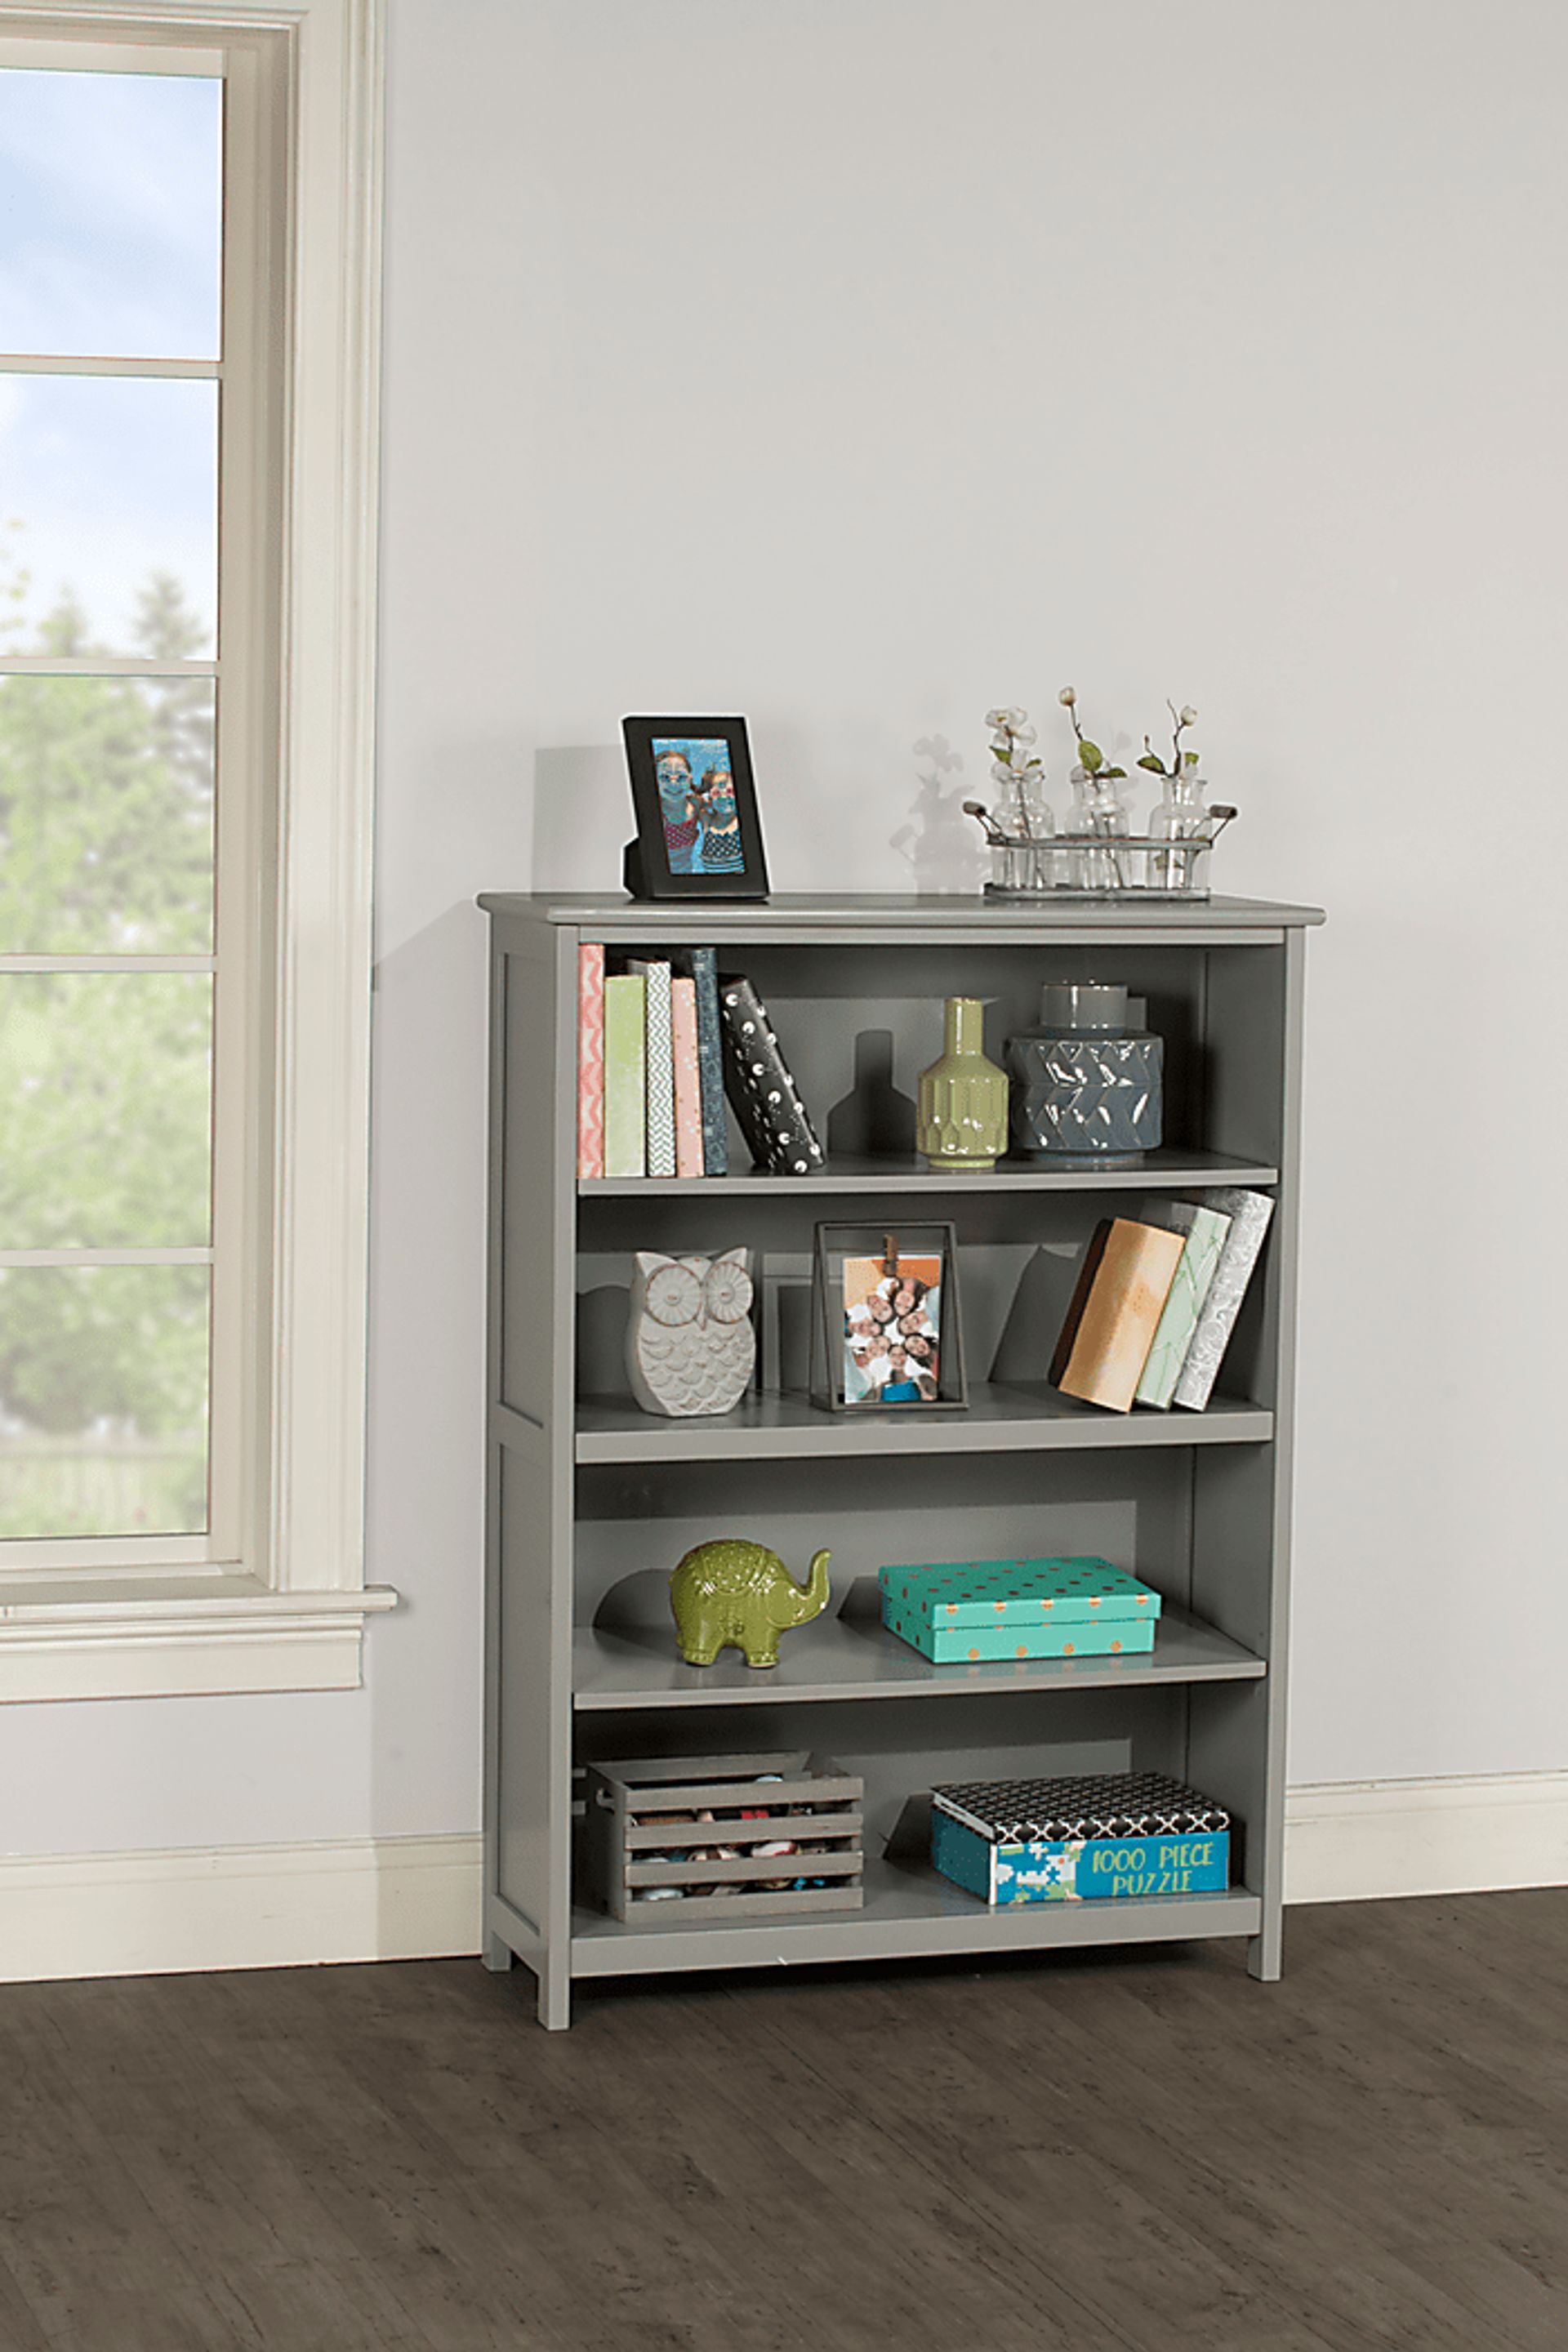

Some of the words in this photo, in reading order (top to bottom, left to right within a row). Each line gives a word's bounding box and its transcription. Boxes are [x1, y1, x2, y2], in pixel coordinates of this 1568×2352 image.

[1093, 1848, 1146, 1873] 1000
[1160, 1842, 1214, 1869] PIECE
[1113, 1871, 1192, 1895] PUZZLE
